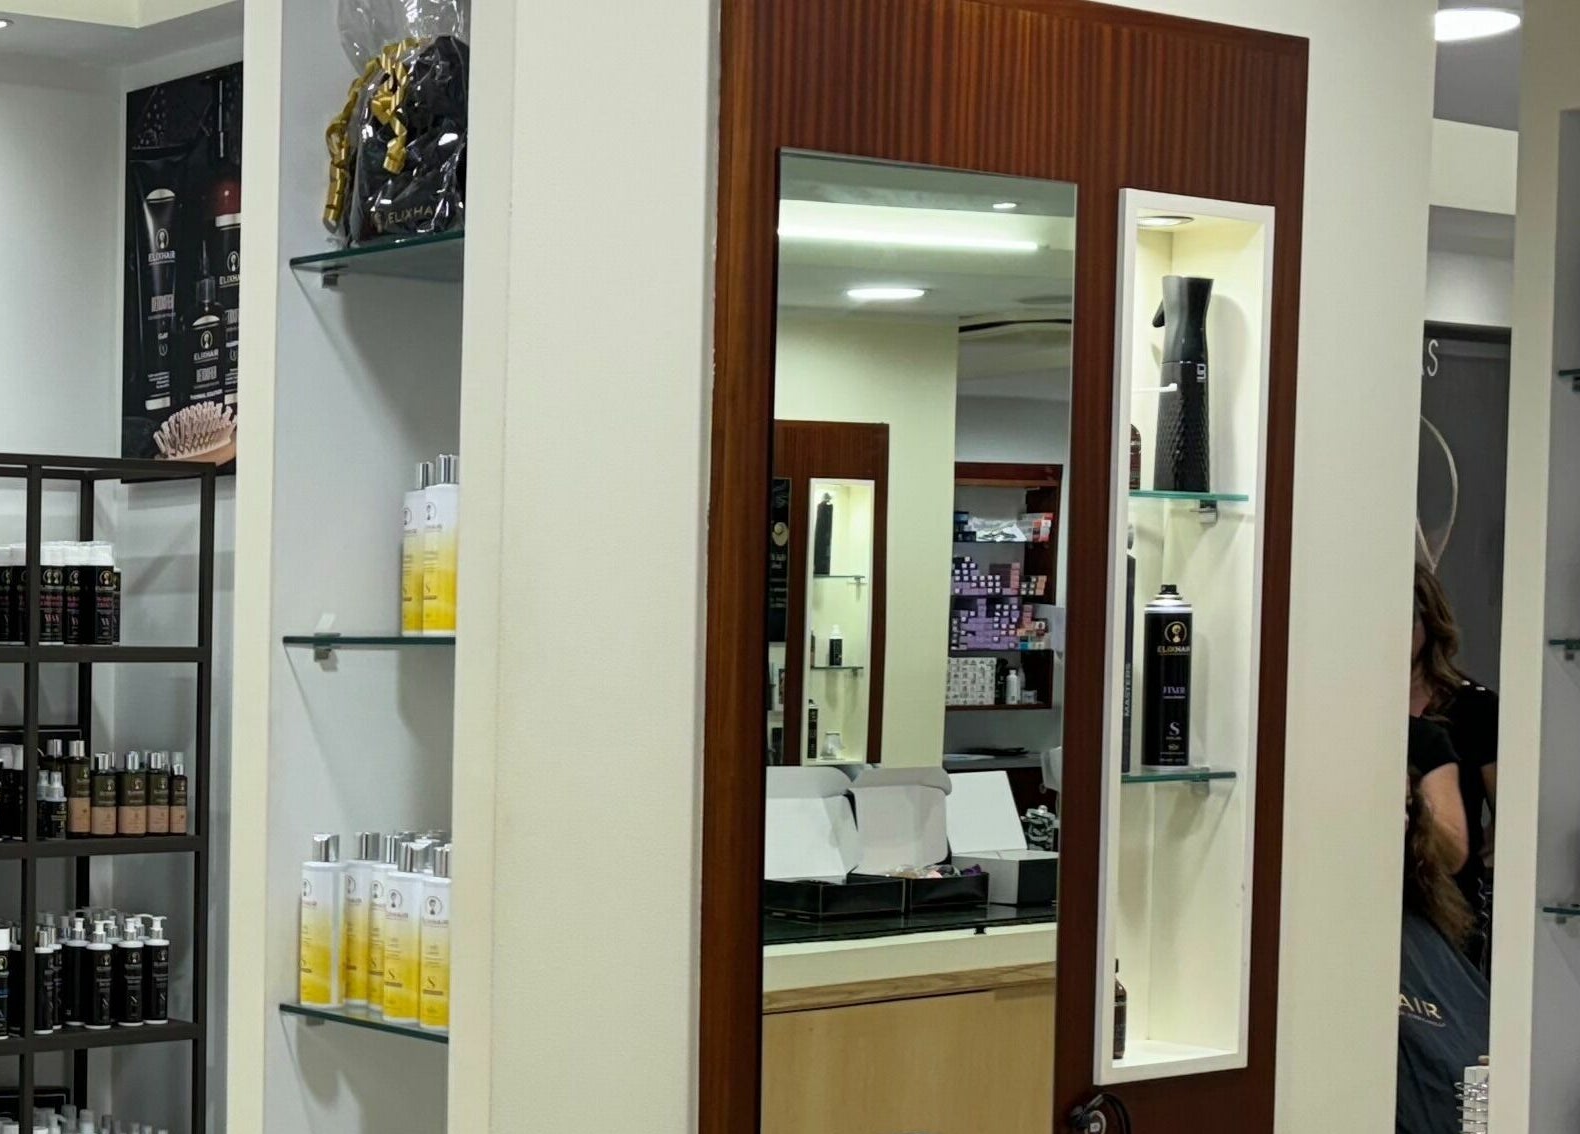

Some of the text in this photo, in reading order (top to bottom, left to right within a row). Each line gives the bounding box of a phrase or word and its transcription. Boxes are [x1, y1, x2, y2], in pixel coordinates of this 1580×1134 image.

[387, 205, 434, 225] ELIXHA
[219, 274, 241, 286] ELIXHA
[1399, 993, 1443, 1019] AIR
